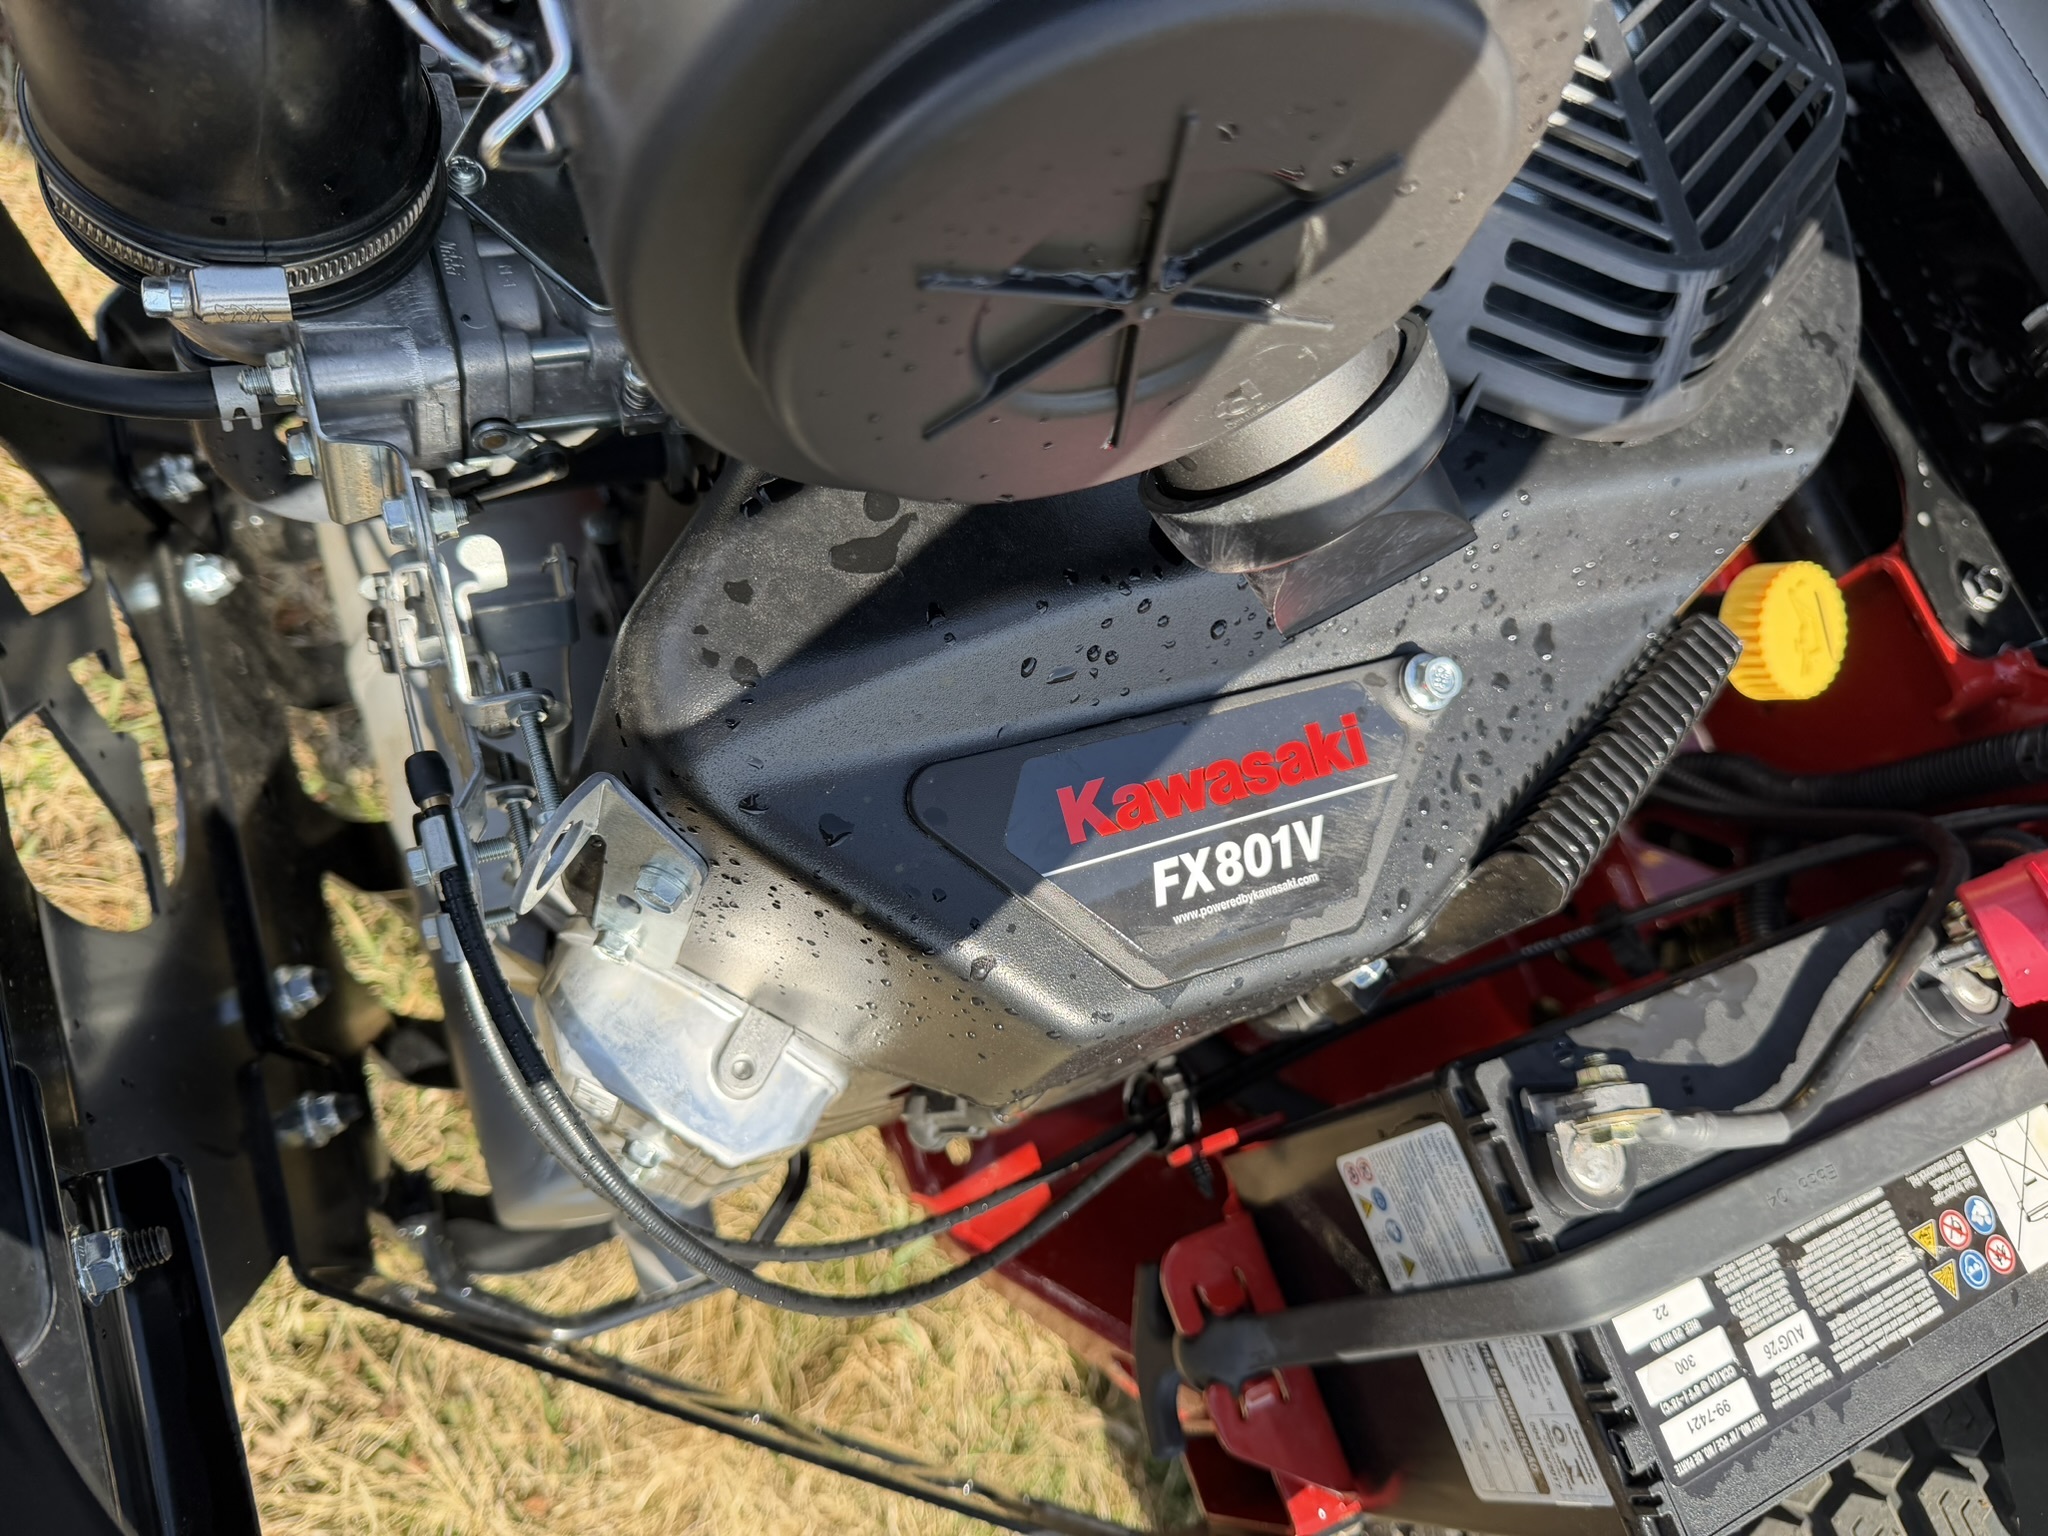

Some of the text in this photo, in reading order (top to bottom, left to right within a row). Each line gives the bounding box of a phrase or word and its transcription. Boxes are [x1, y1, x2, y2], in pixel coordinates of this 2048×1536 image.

[439, 240, 465, 277] Nikki
[1056, 712, 1370, 845] Kawasaki
[1153, 814, 1324, 907] FX801V
[1172, 872, 1319, 925] www.poweredbykawasaki.com
[1652, 1303, 1669, 1320] 22
[1762, 1323, 1804, 1360] AUG'26
[1674, 1354, 1696, 1374] 300
[1718, 1363, 1738, 1383] CCA
[1686, 1399, 1732, 1434] 99-7421
[1748, 1412, 1768, 1431] PART
[1737, 1421, 1753, 1438] NO.
[1672, 1455, 1697, 1477] PARTE
[1691, 1450, 1706, 1466] DE
